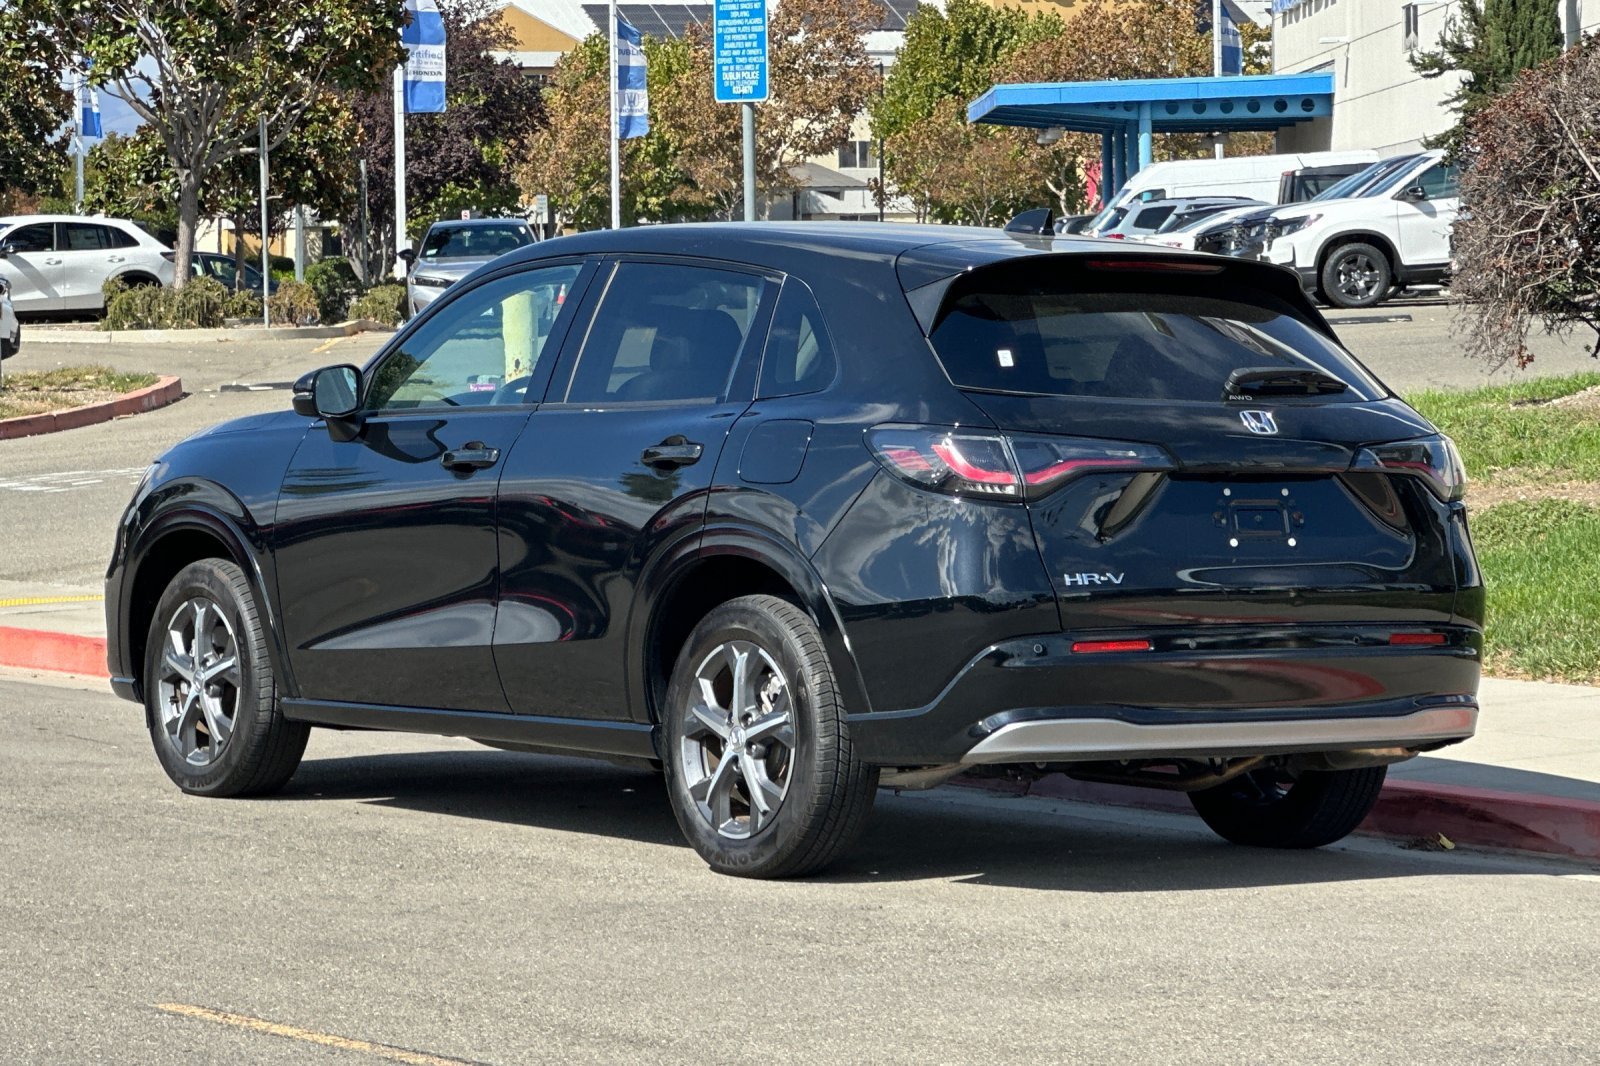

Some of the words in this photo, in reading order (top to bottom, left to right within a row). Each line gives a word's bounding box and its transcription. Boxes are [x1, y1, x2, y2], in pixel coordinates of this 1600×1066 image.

[410, 49, 444, 60] ertified
[741, 70, 760, 79] POLICE
[1063, 572, 1125, 586] HR-V
